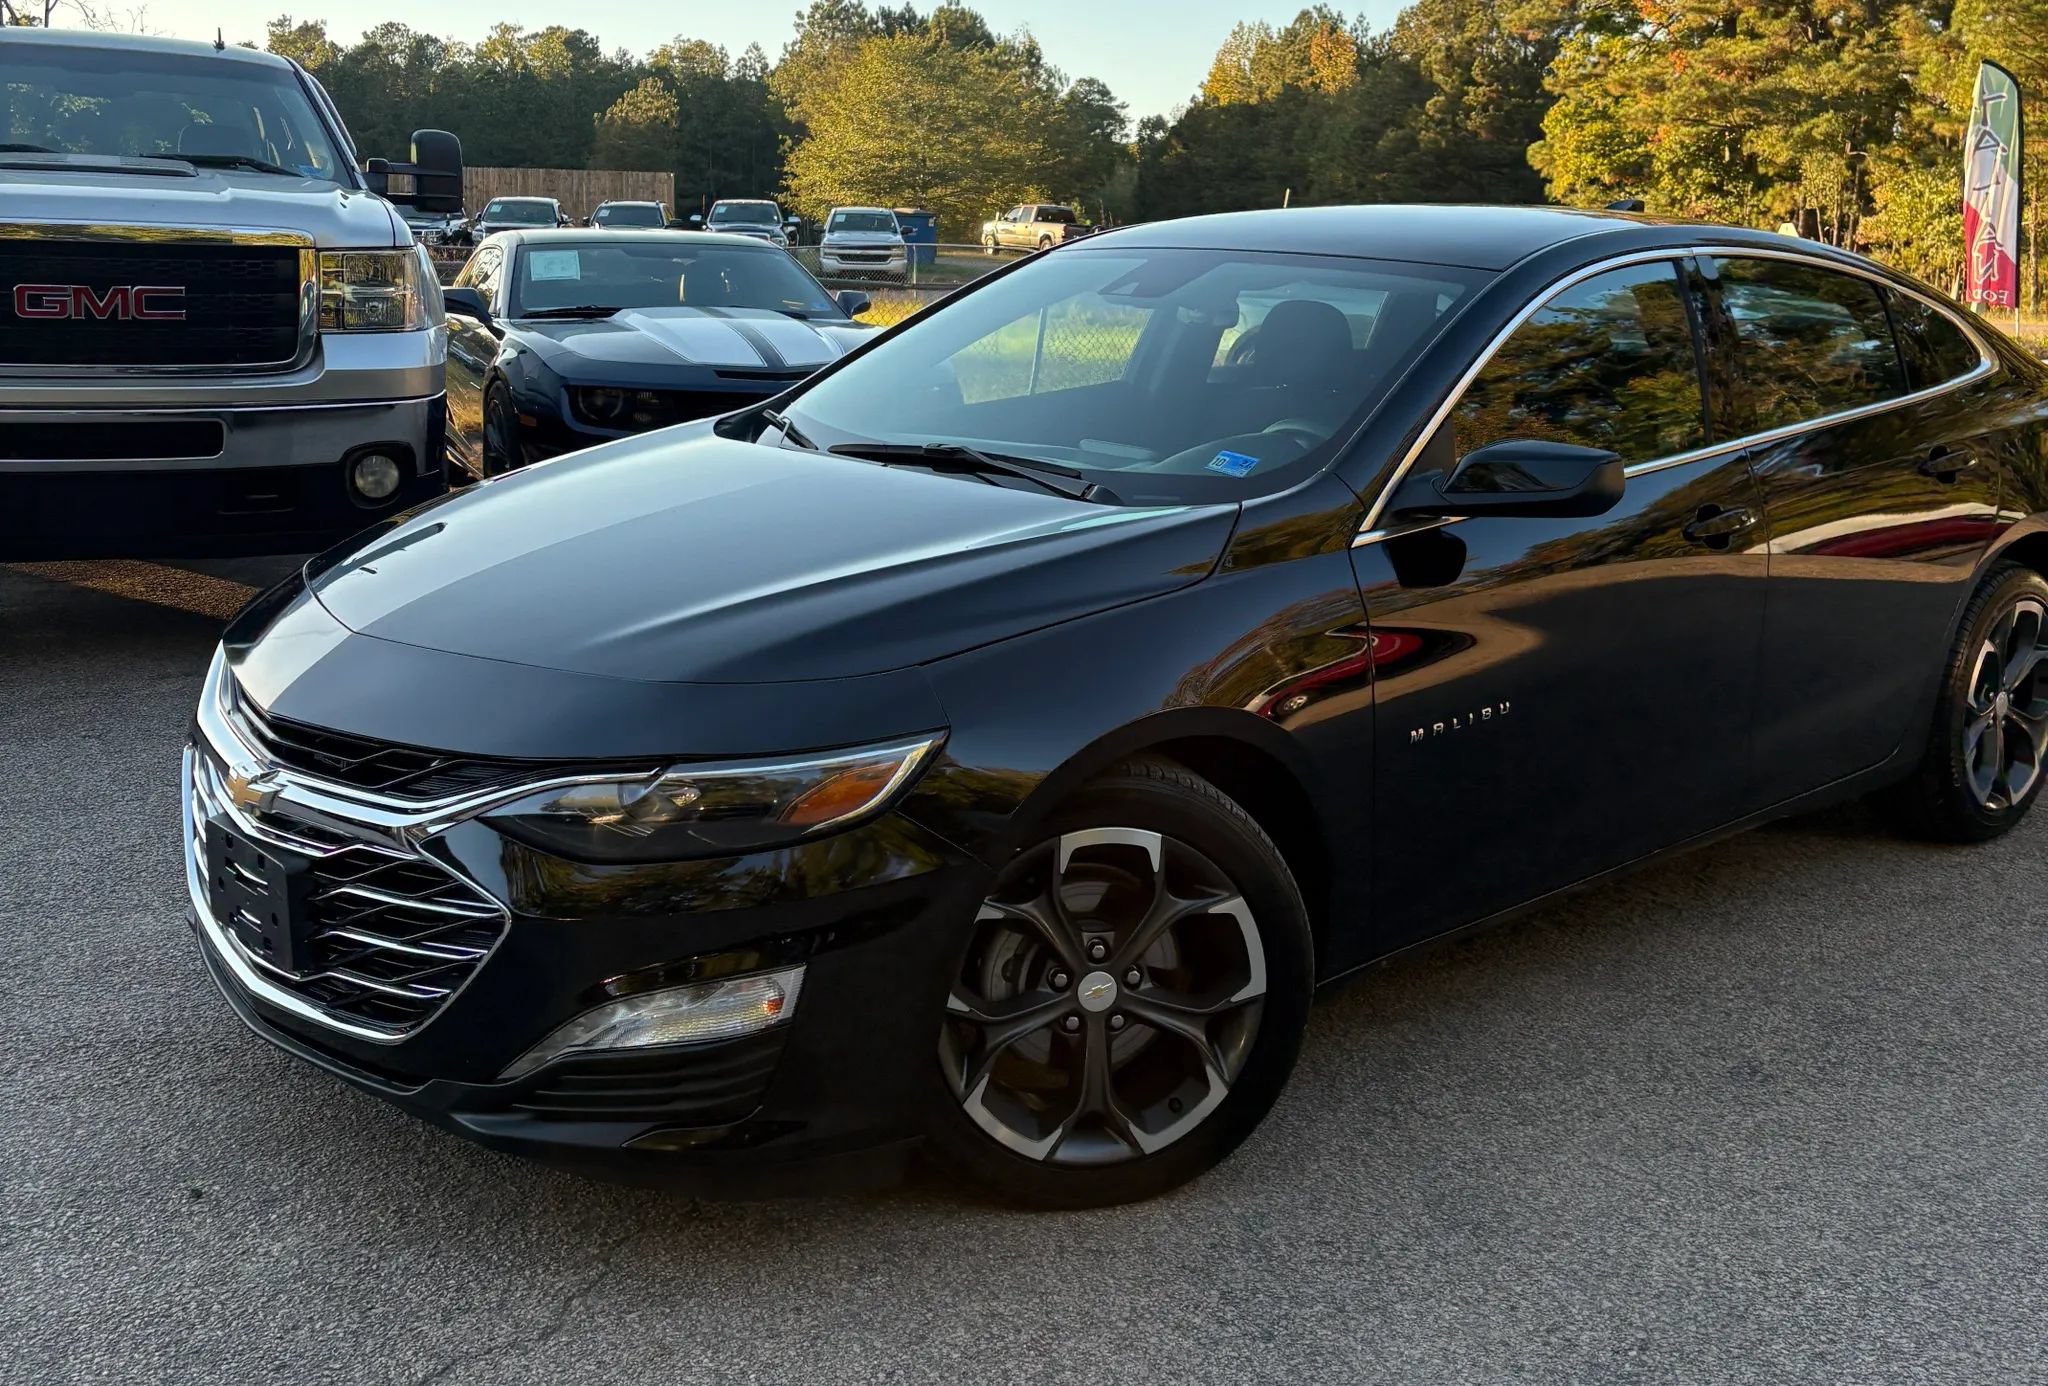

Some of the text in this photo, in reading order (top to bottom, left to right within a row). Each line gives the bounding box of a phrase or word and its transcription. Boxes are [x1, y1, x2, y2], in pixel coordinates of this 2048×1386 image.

[13, 284, 186, 320] GMC
[1211, 457, 1226, 467] 10
[1410, 701, 1510, 744] MALIBU
